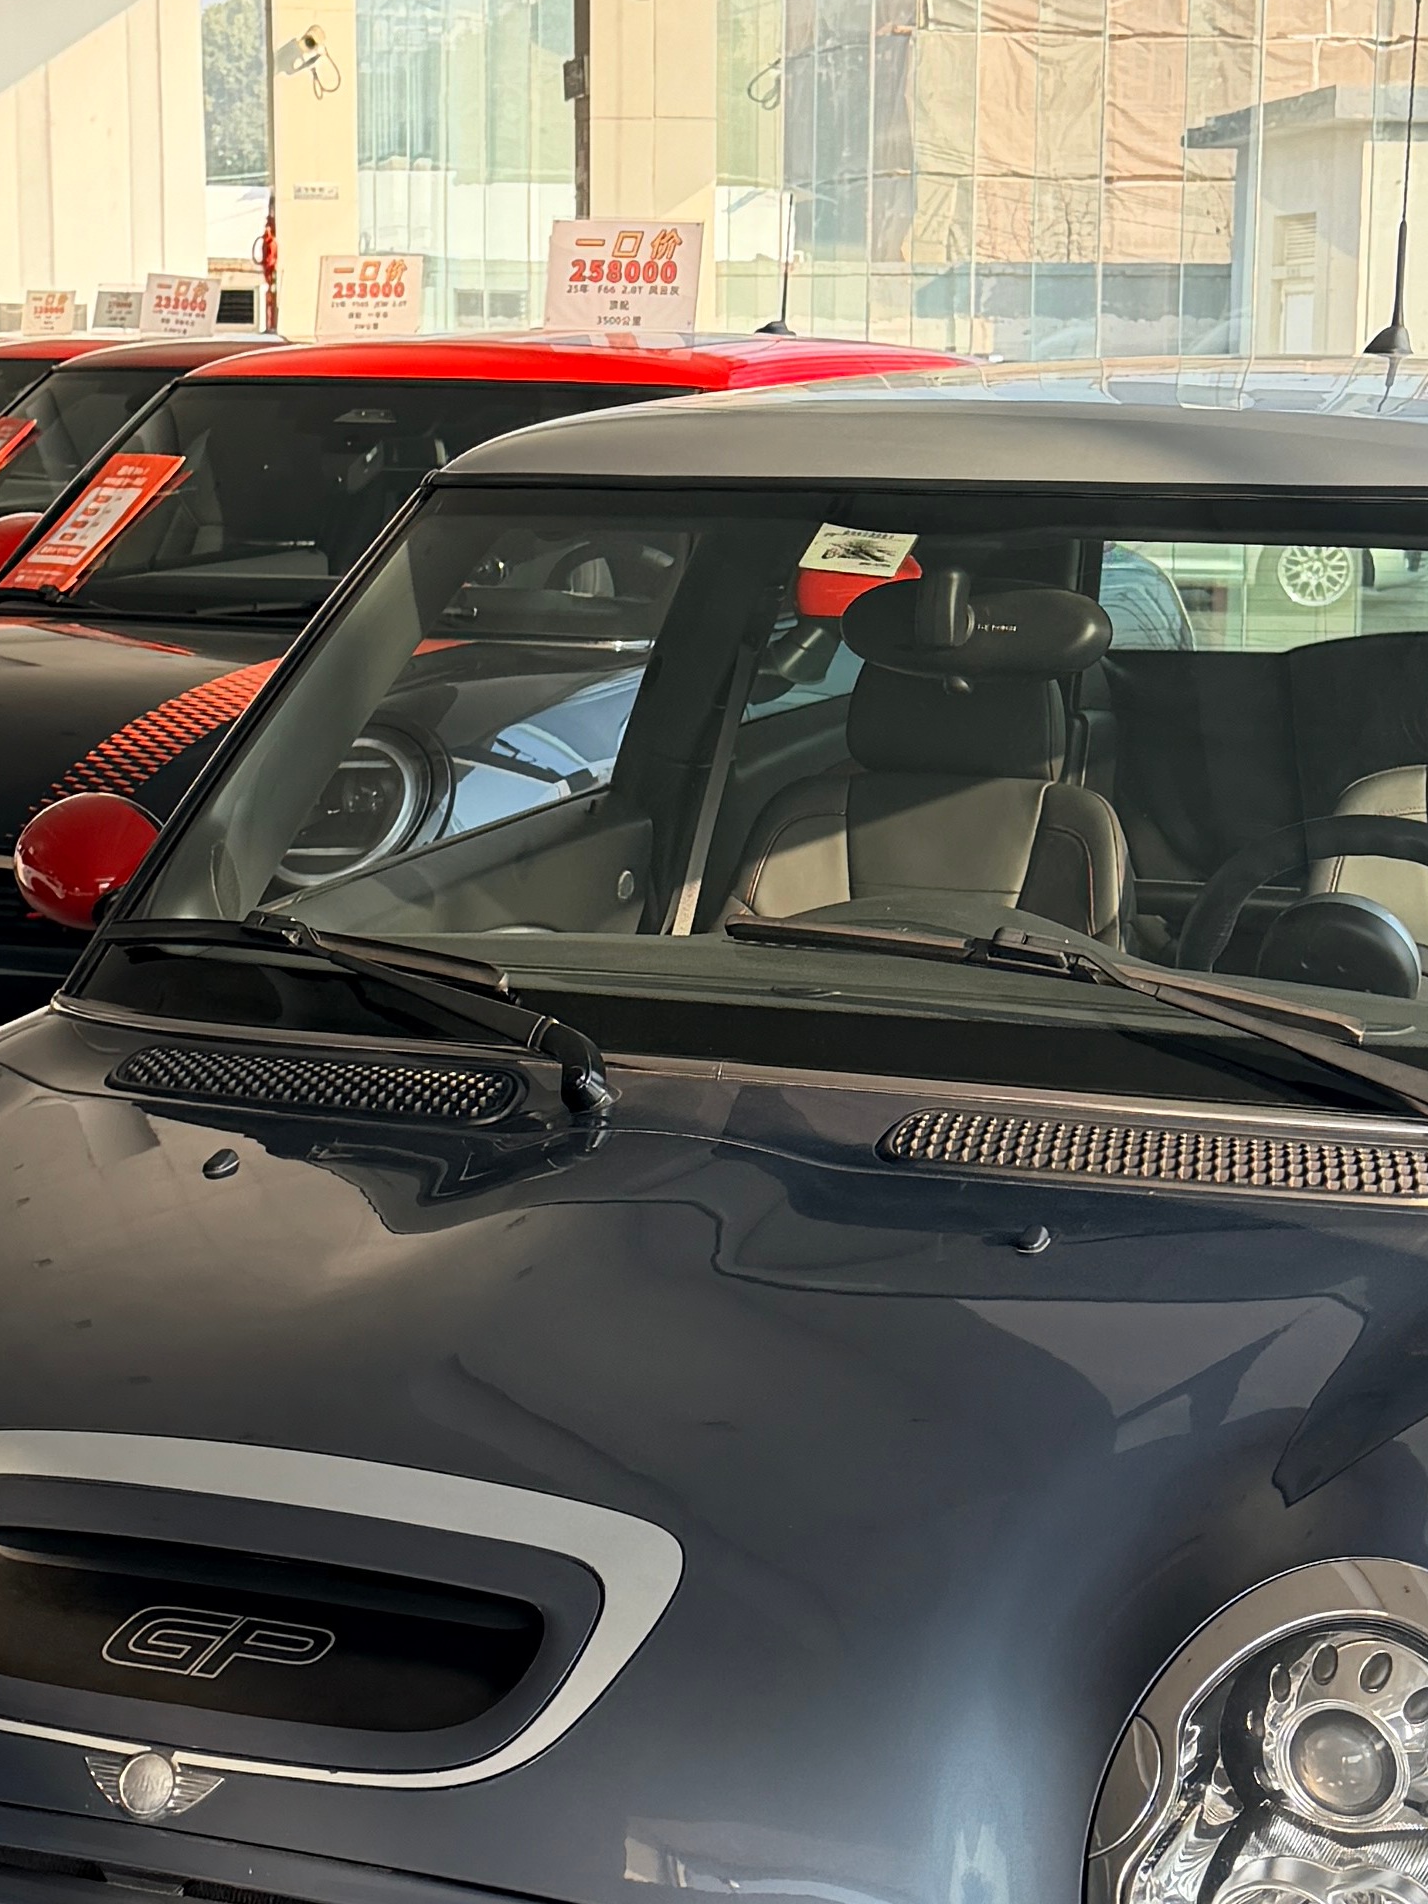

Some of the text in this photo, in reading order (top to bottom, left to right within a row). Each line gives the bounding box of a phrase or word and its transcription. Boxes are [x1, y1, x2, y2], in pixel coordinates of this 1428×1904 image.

[575, 228, 683, 260] 一口价
[333, 259, 408, 283] 一口价
[569, 259, 678, 283] 258000
[157, 280, 210, 302] 一口价
[332, 282, 405, 300] 253000
[102, 1605, 336, 1679] GP
